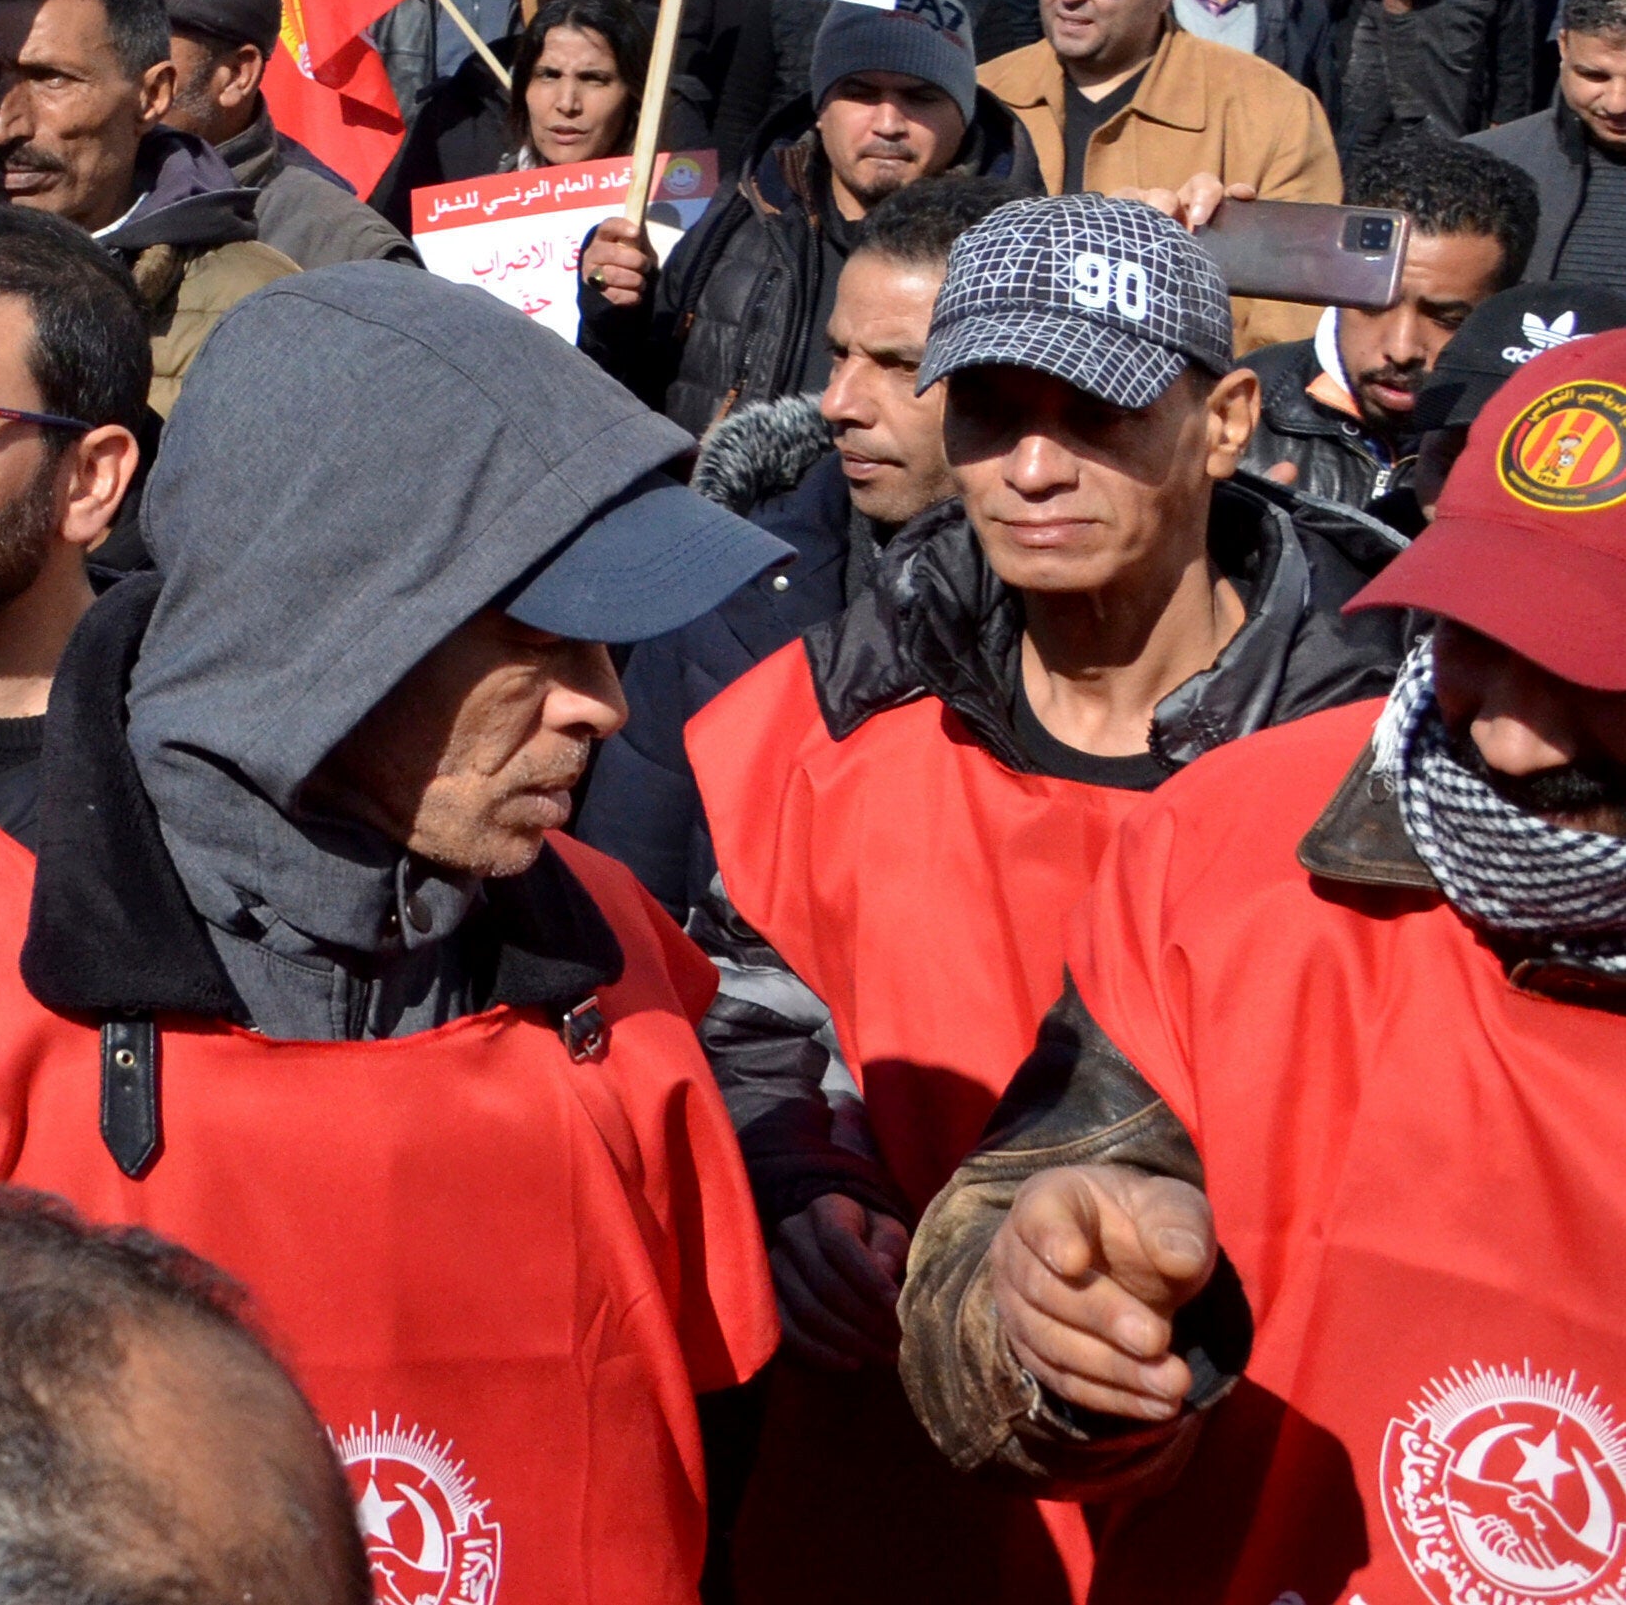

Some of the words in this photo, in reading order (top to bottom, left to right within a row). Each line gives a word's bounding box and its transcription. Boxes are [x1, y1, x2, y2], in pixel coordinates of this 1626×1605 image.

[426, 190, 480, 222] للشغل
[482, 179, 550, 216] التونسي
[554, 173, 594, 202] العام
[471, 241, 553, 283] الاضراب
[1074, 253, 1147, 321] 90
